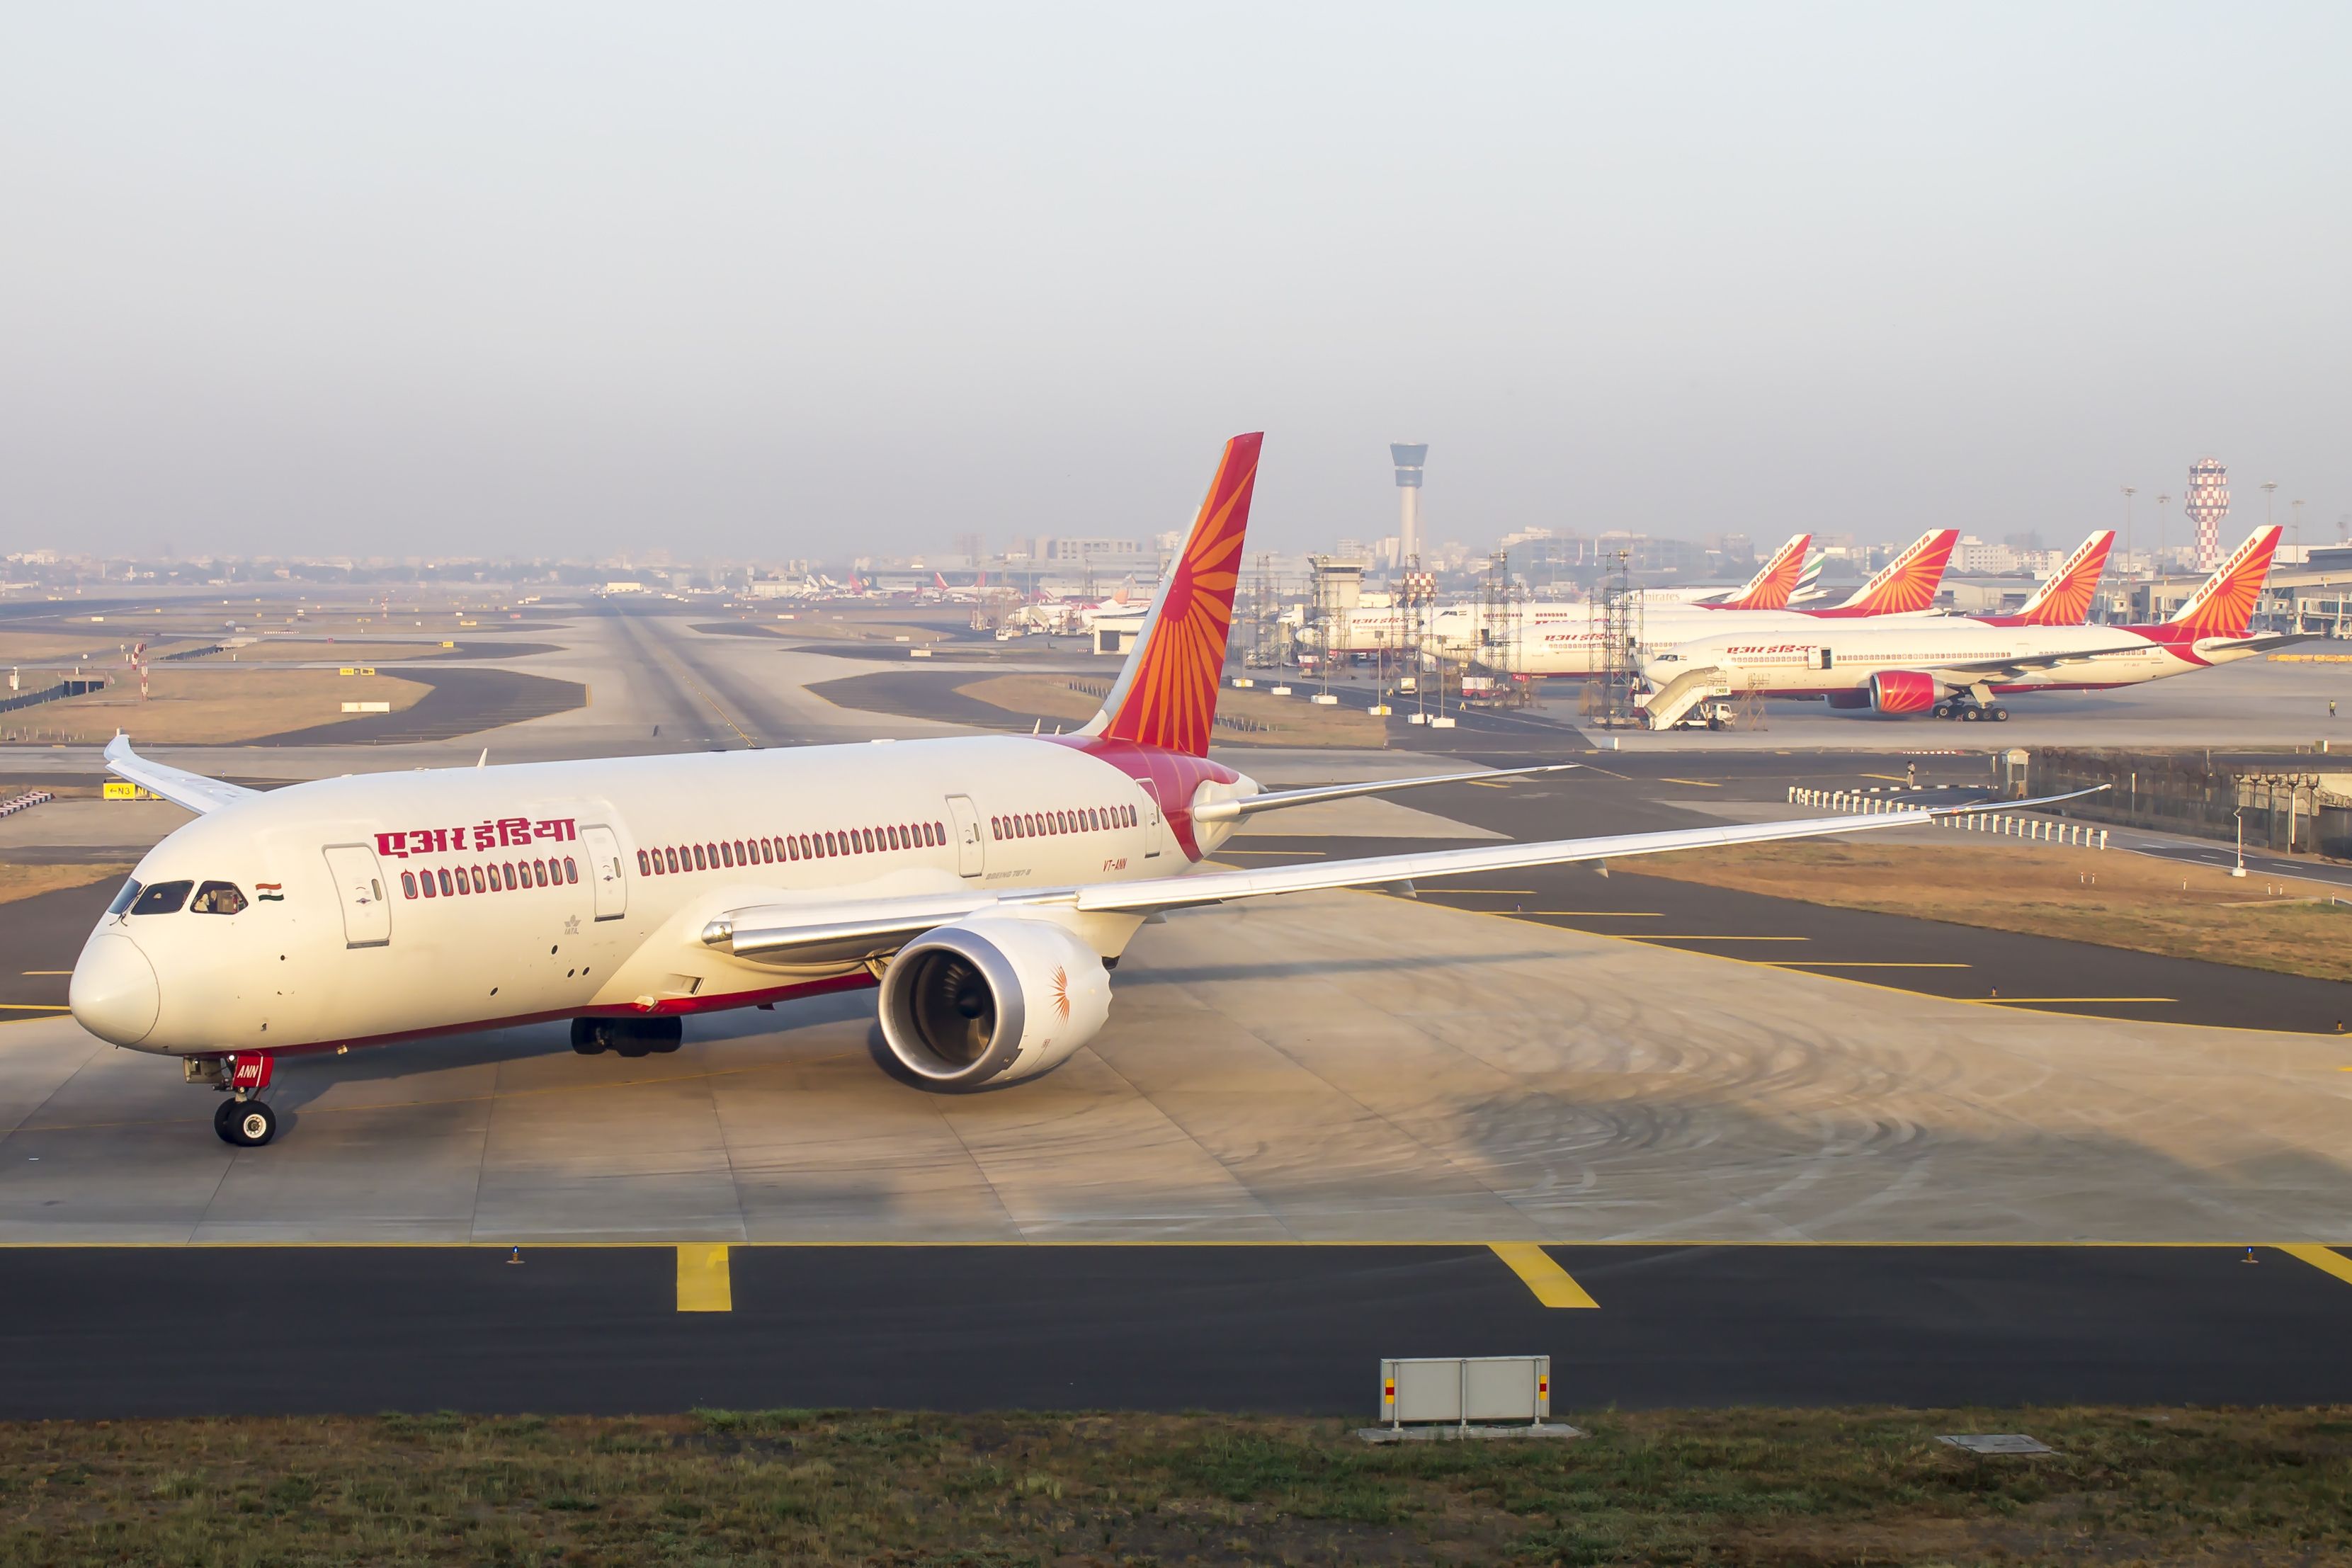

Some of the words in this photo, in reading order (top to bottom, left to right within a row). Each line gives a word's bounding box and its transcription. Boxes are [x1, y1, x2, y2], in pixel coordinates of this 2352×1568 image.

[1751, 571, 1766, 589] AIR
[1768, 542, 1793, 571] INDIA
[1870, 567, 1891, 590] AIR
[1894, 534, 1930, 569] INDIA
[2040, 575, 2060, 598] AIR
[2062, 540, 2093, 576] INDIA
[2196, 577, 2217, 604] AIR
[2220, 538, 2256, 579] INDIA
[374, 827, 467, 858] एअर
[473, 817, 575, 852] इंडिया
[985, 871, 1012, 880] BOEING
[1103, 858, 1127, 873] VT-ANN
[237, 1064, 259, 1079] ANN
